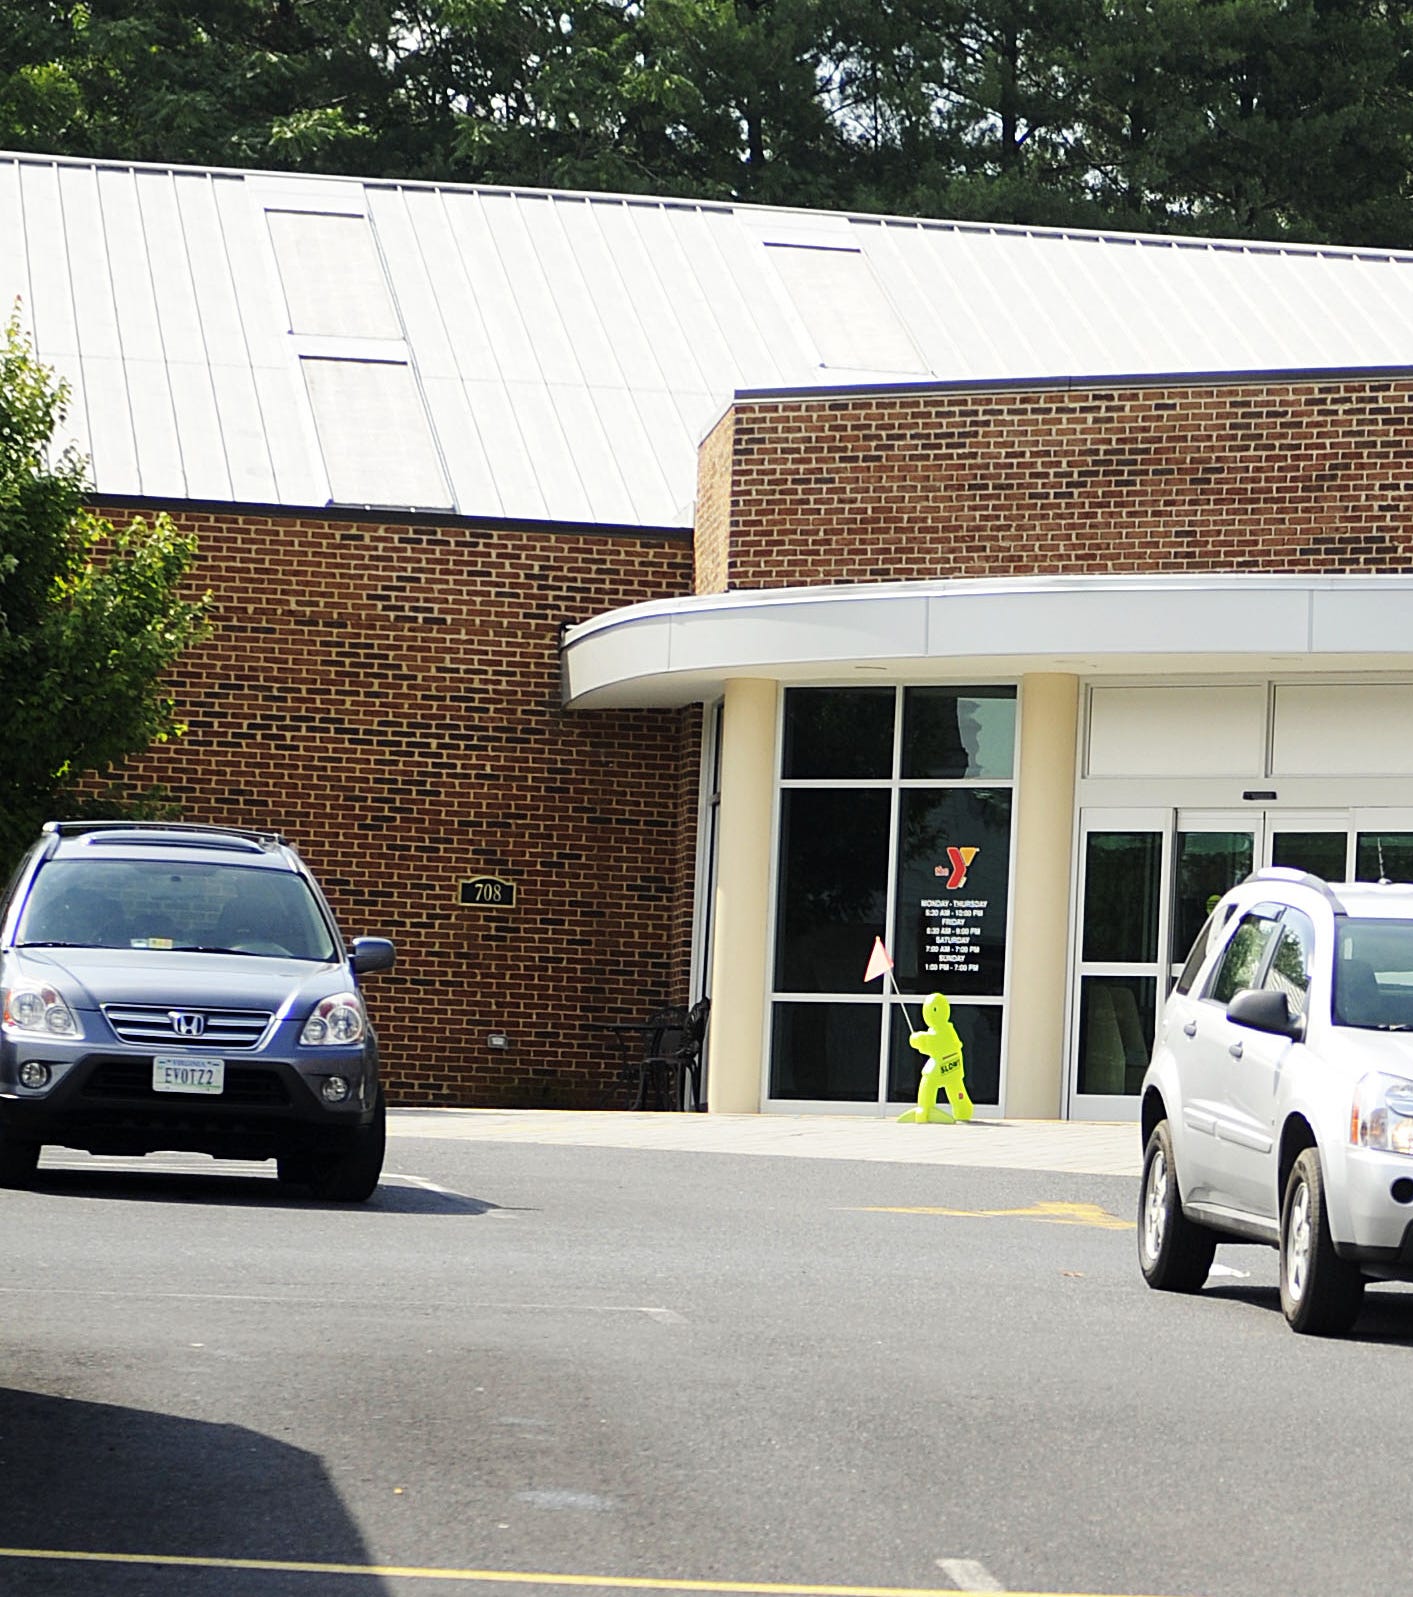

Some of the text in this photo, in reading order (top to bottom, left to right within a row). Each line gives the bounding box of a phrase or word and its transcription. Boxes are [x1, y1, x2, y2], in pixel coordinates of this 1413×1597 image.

[474, 883, 502, 902] 708
[921, 899, 949, 908] MONDAY
[953, 900, 988, 908] THURSDAY
[941, 918, 966, 926] FRIDAY
[935, 936, 970, 944] SATURDAY
[938, 954, 966, 962] SUNDAY
